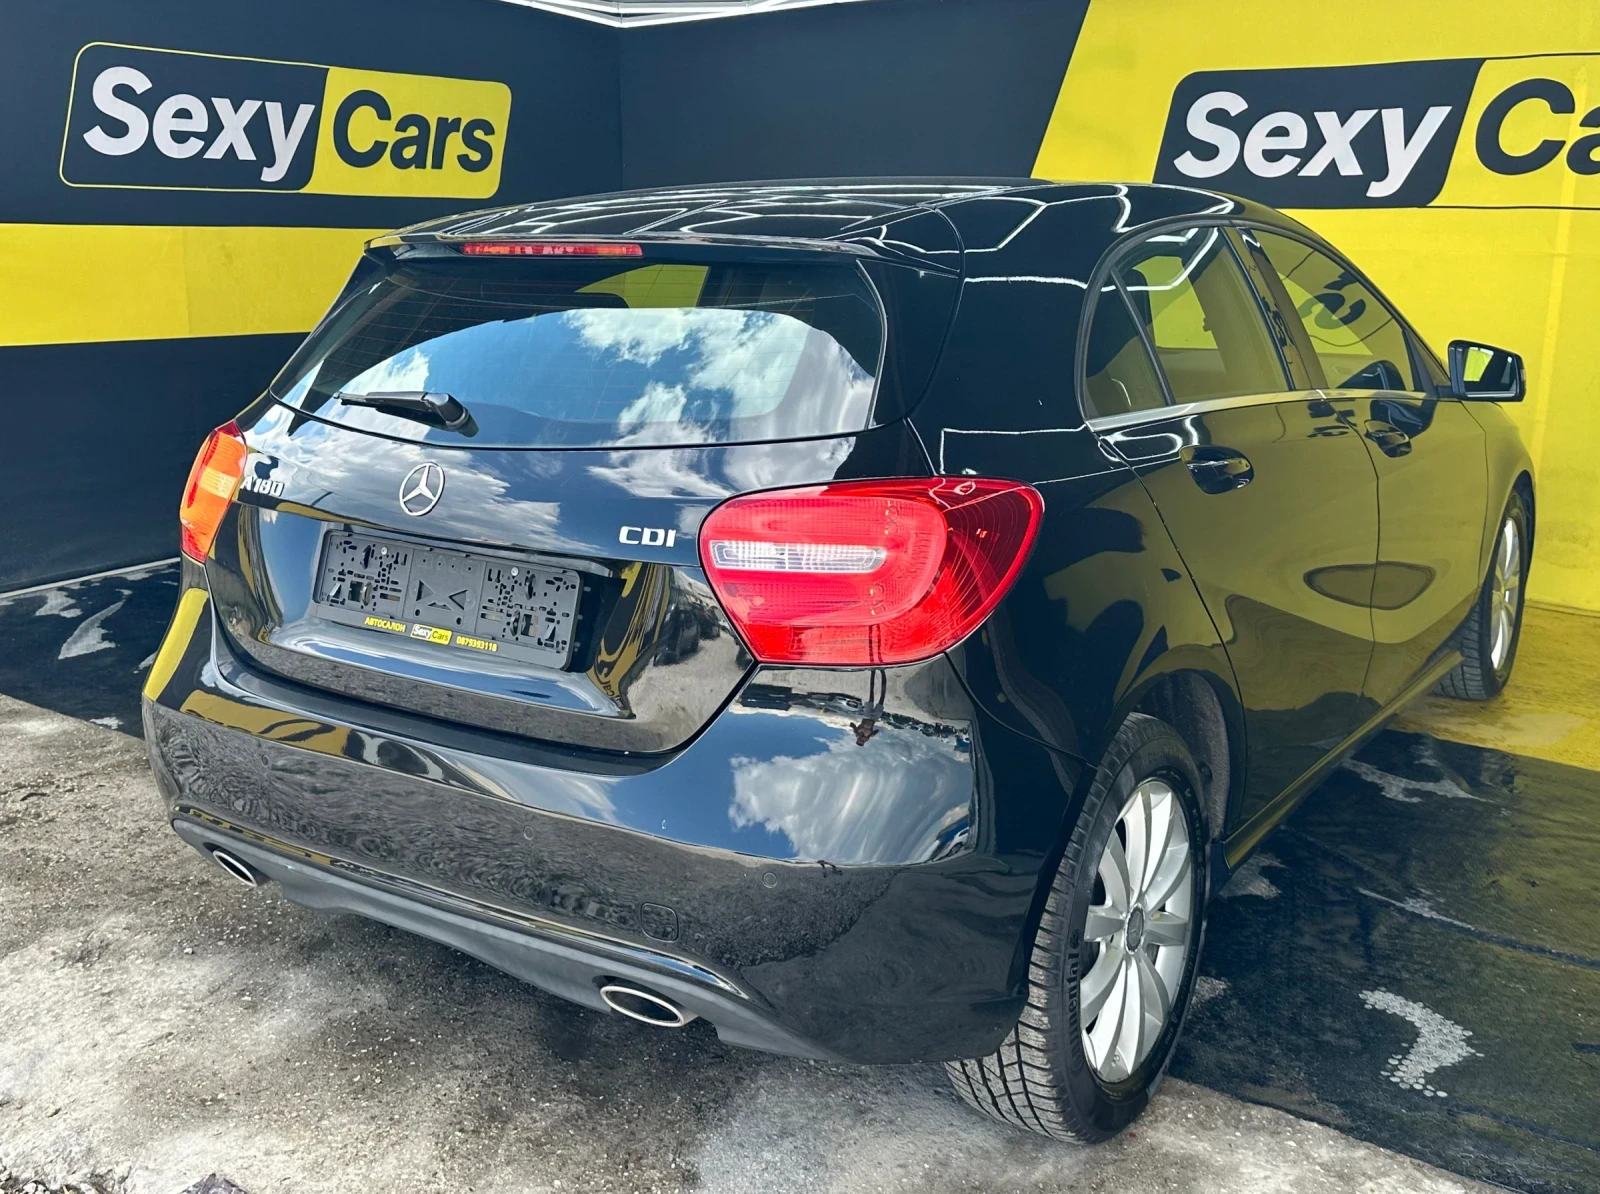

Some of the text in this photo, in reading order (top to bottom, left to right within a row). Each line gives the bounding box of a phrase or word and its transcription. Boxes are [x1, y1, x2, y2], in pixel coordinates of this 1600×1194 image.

[83, 66, 496, 183] Sexy Cars
[1173, 91, 1453, 198] Sexy
[619, 525, 677, 548] CDI
[364, 616, 406, 633] АВТОСАЛОН
[432, 630, 450, 642] Cars
